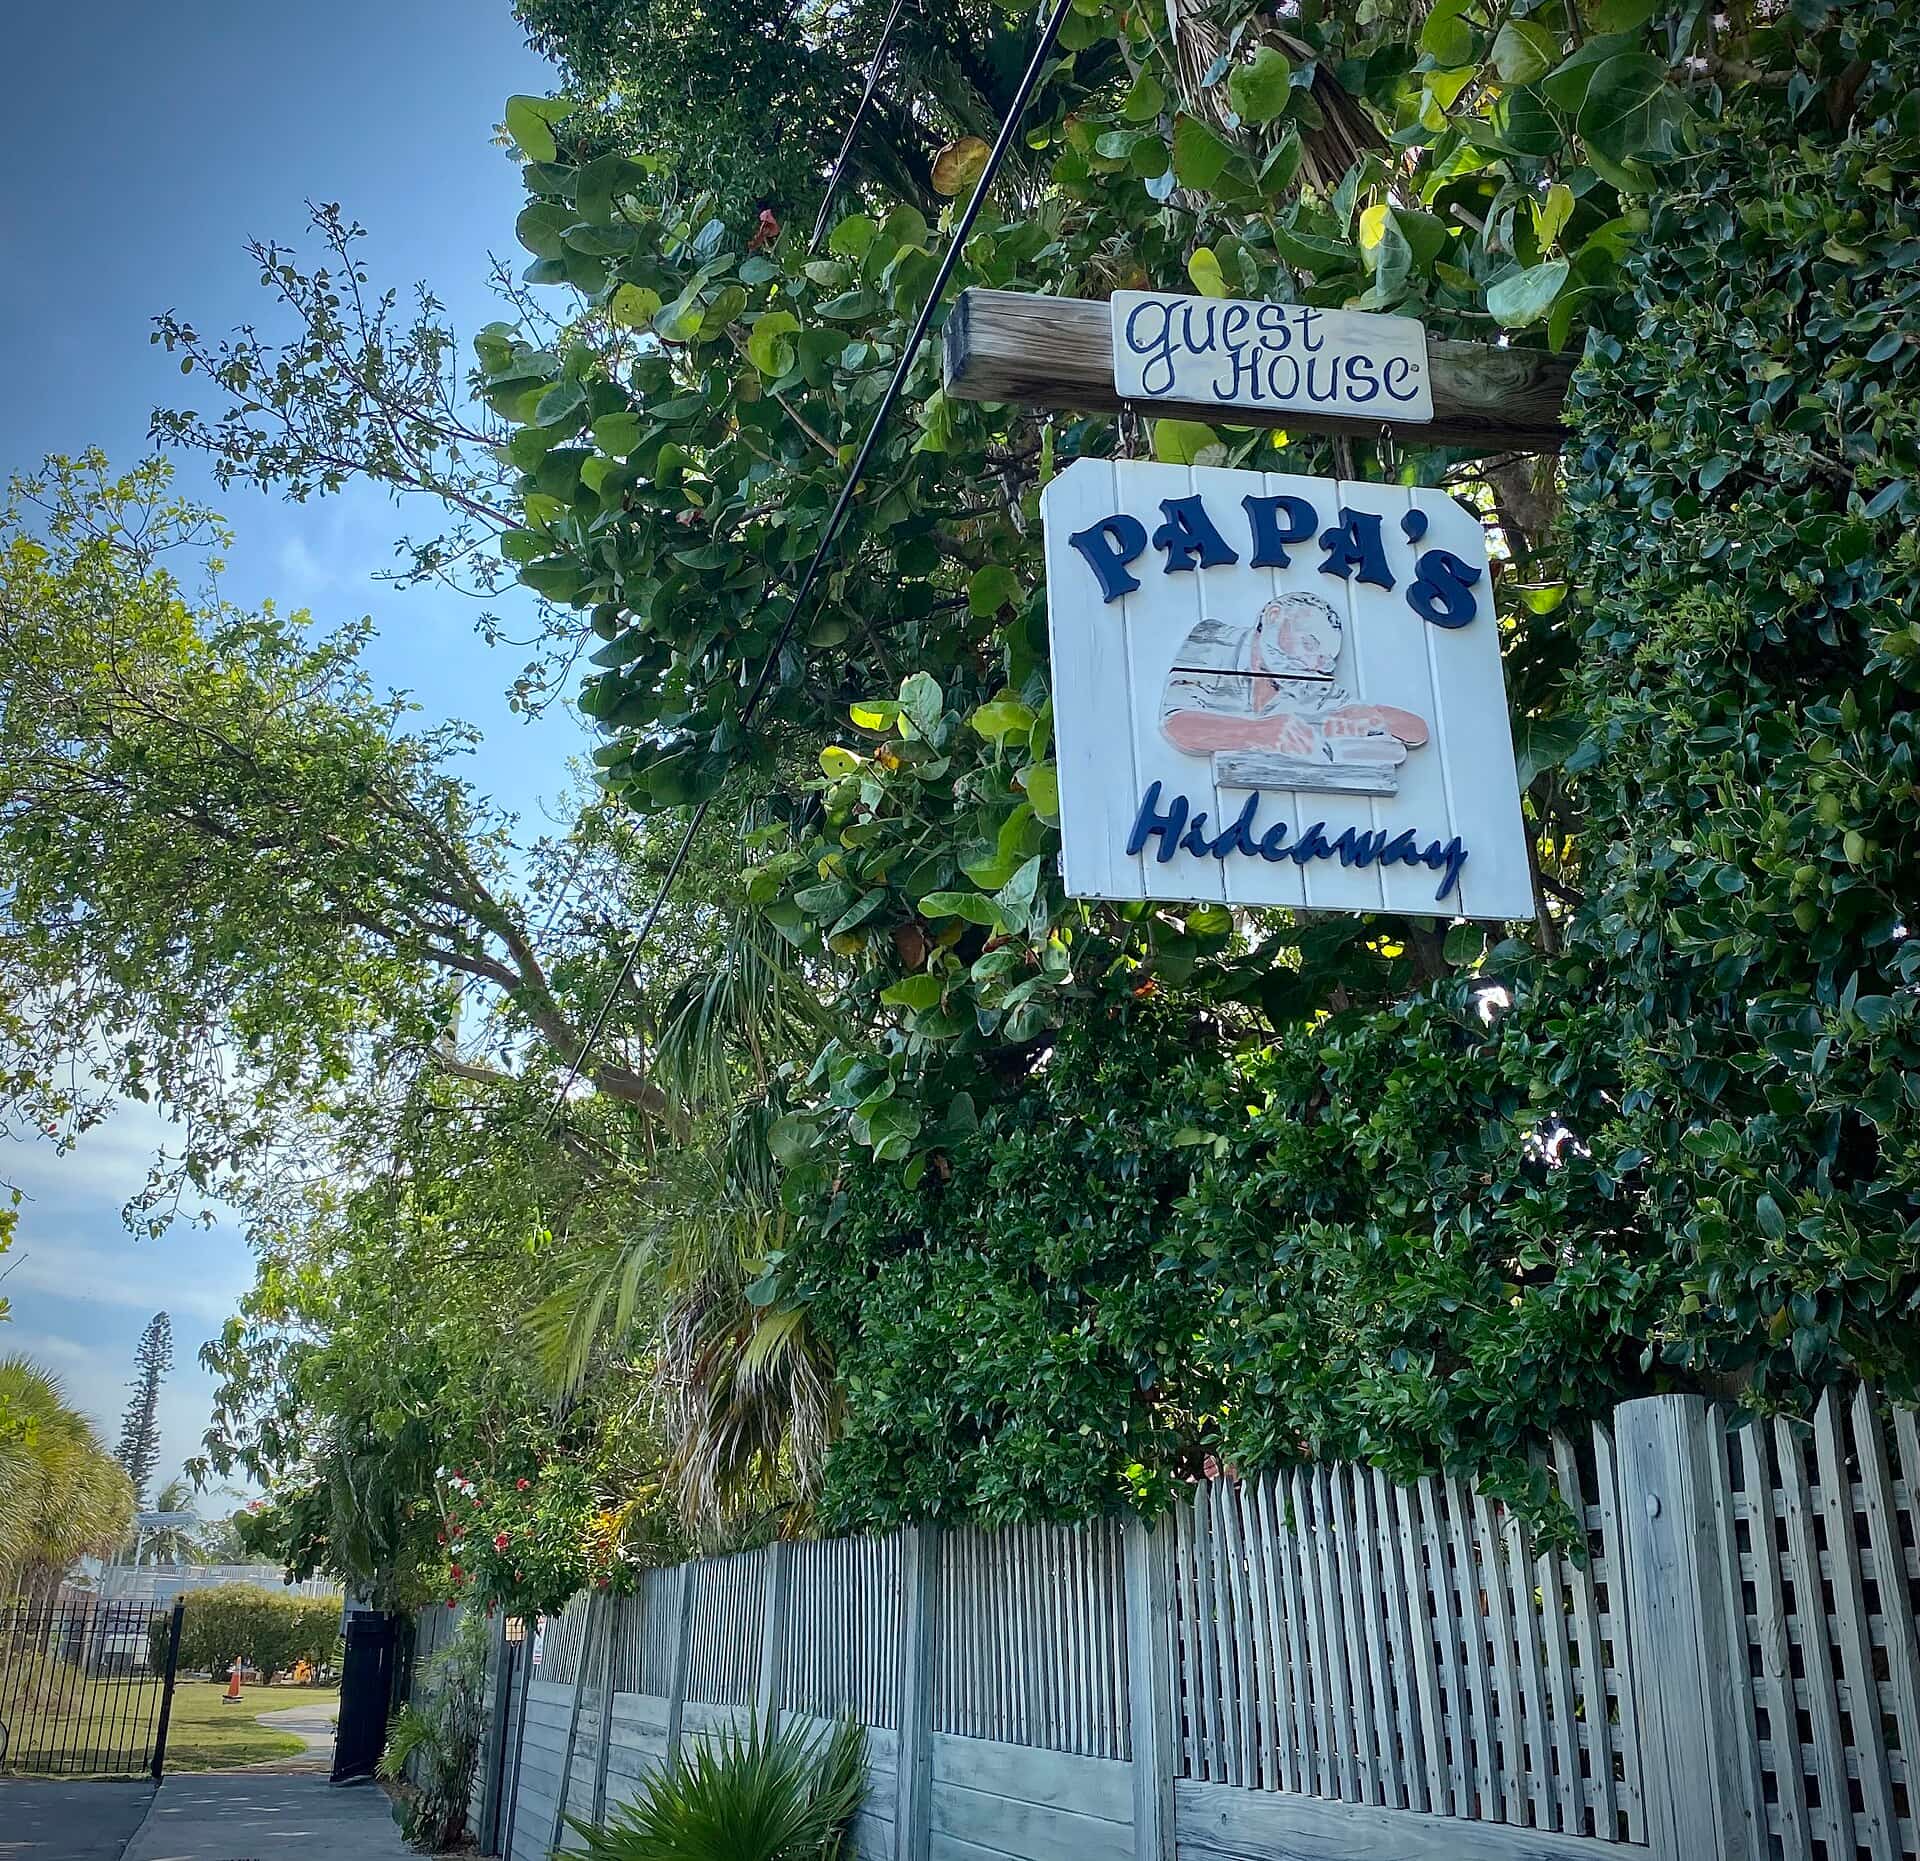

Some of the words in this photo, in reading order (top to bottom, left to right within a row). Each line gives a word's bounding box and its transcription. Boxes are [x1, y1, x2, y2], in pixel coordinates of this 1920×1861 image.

[1126, 299, 1324, 395] guest
[1213, 347, 1419, 402] House
[1068, 493, 1482, 629] PAPA'S
[1126, 780, 1469, 901] Hideaway
